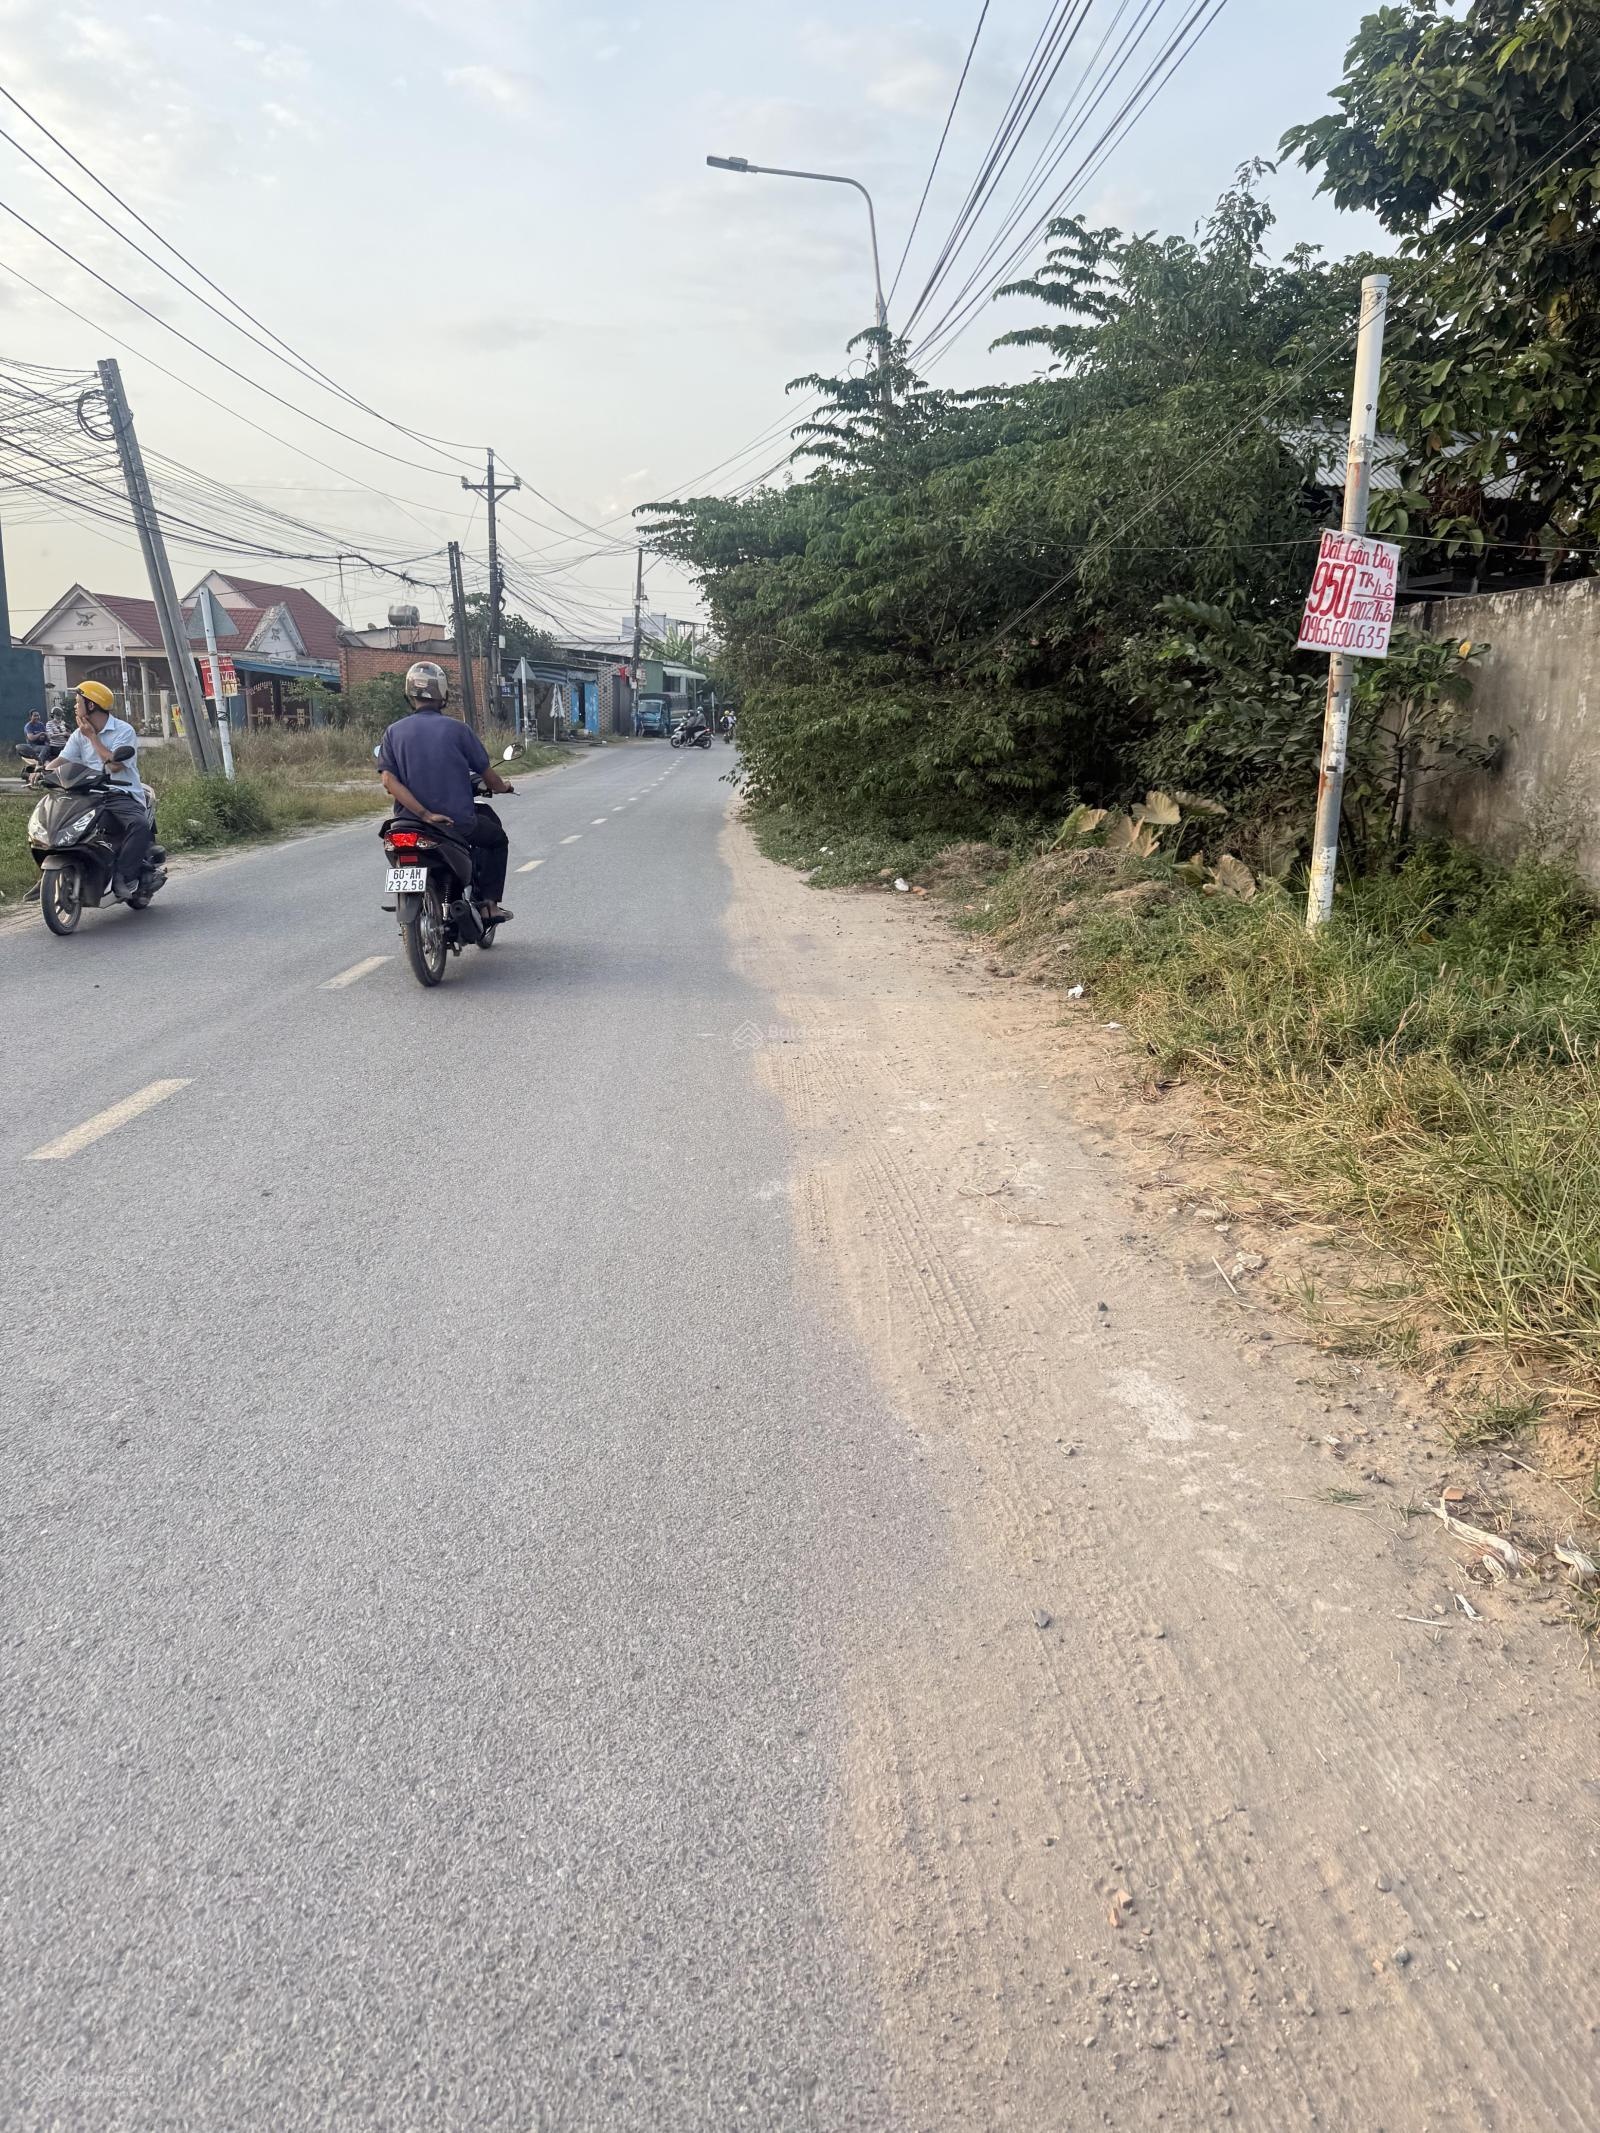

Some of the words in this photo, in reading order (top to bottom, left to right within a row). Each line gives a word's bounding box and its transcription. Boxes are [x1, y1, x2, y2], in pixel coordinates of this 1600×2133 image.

[1321, 533, 1344, 559] Đất
[1345, 539, 1370, 566] Gần
[1308, 562, 1356, 618] 950
[1299, 615, 1386, 649] 0965.690.635
[388, 880, 424, 891] 232.58
[393, 869, 421, 879] 60-AH
